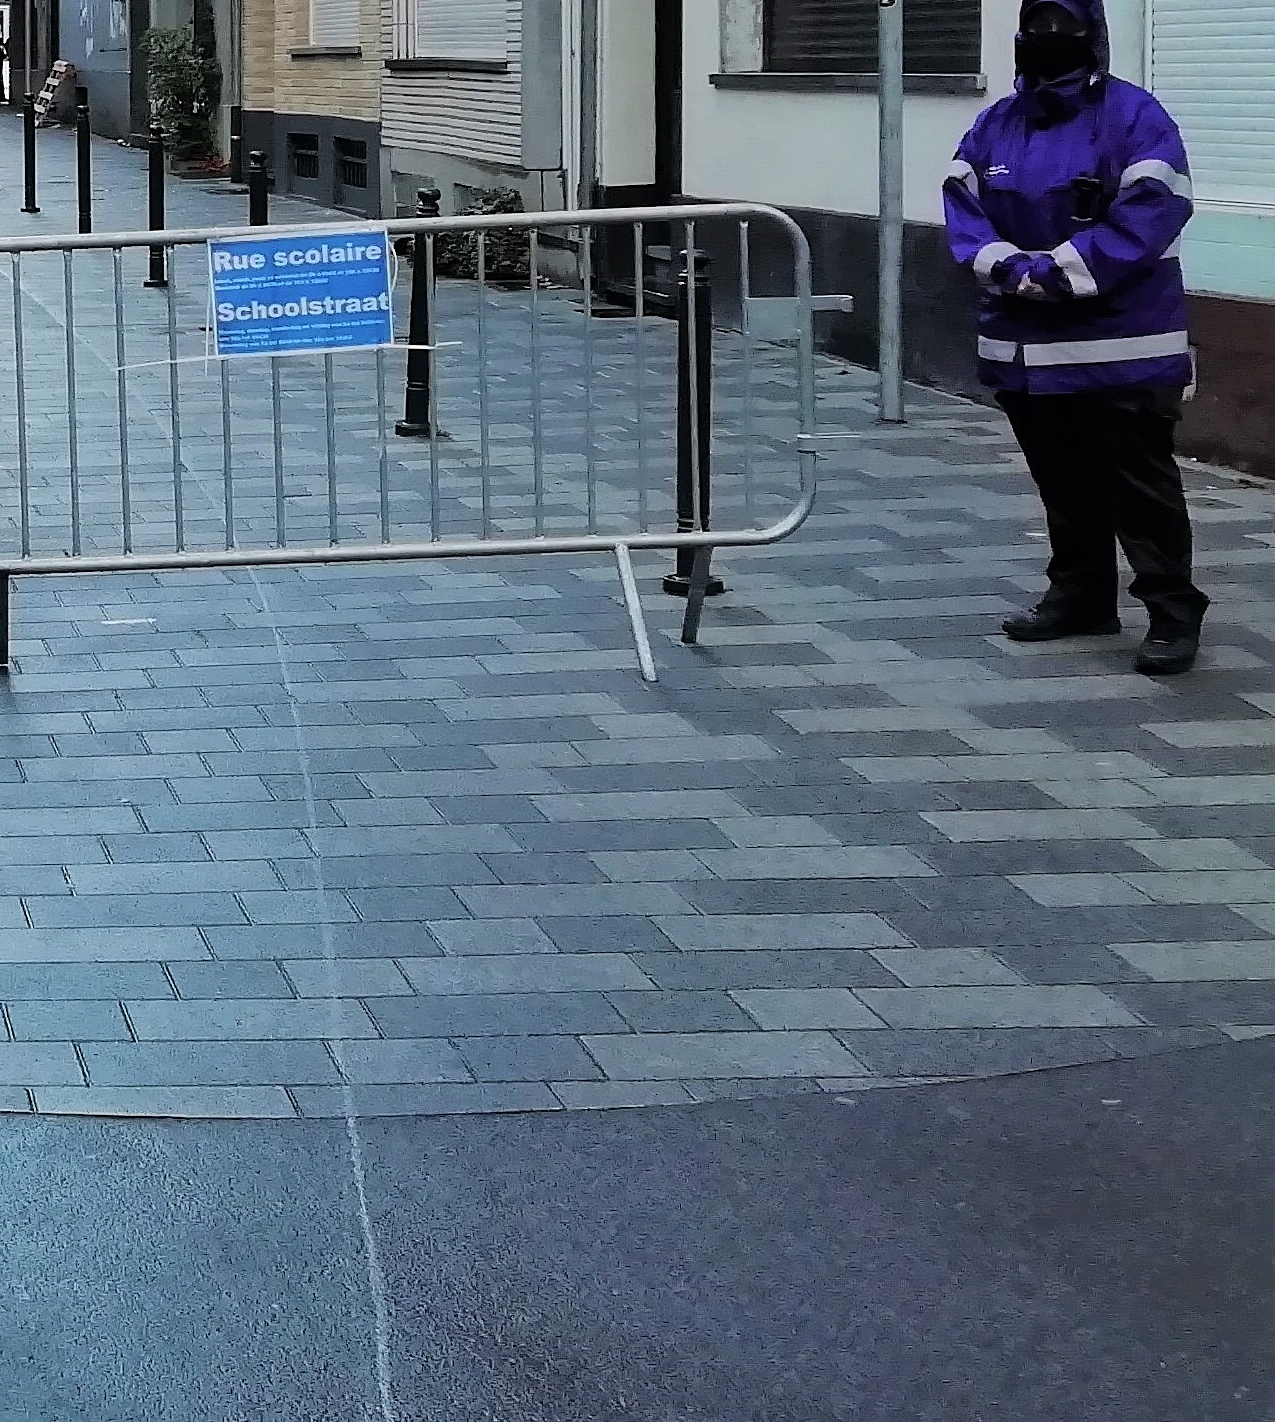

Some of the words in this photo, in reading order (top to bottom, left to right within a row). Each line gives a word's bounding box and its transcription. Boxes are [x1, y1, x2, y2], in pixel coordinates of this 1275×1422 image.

[214, 251, 266, 272] Rue
[274, 243, 382, 265] scolaire
[218, 292, 390, 322] Schoolstraat
